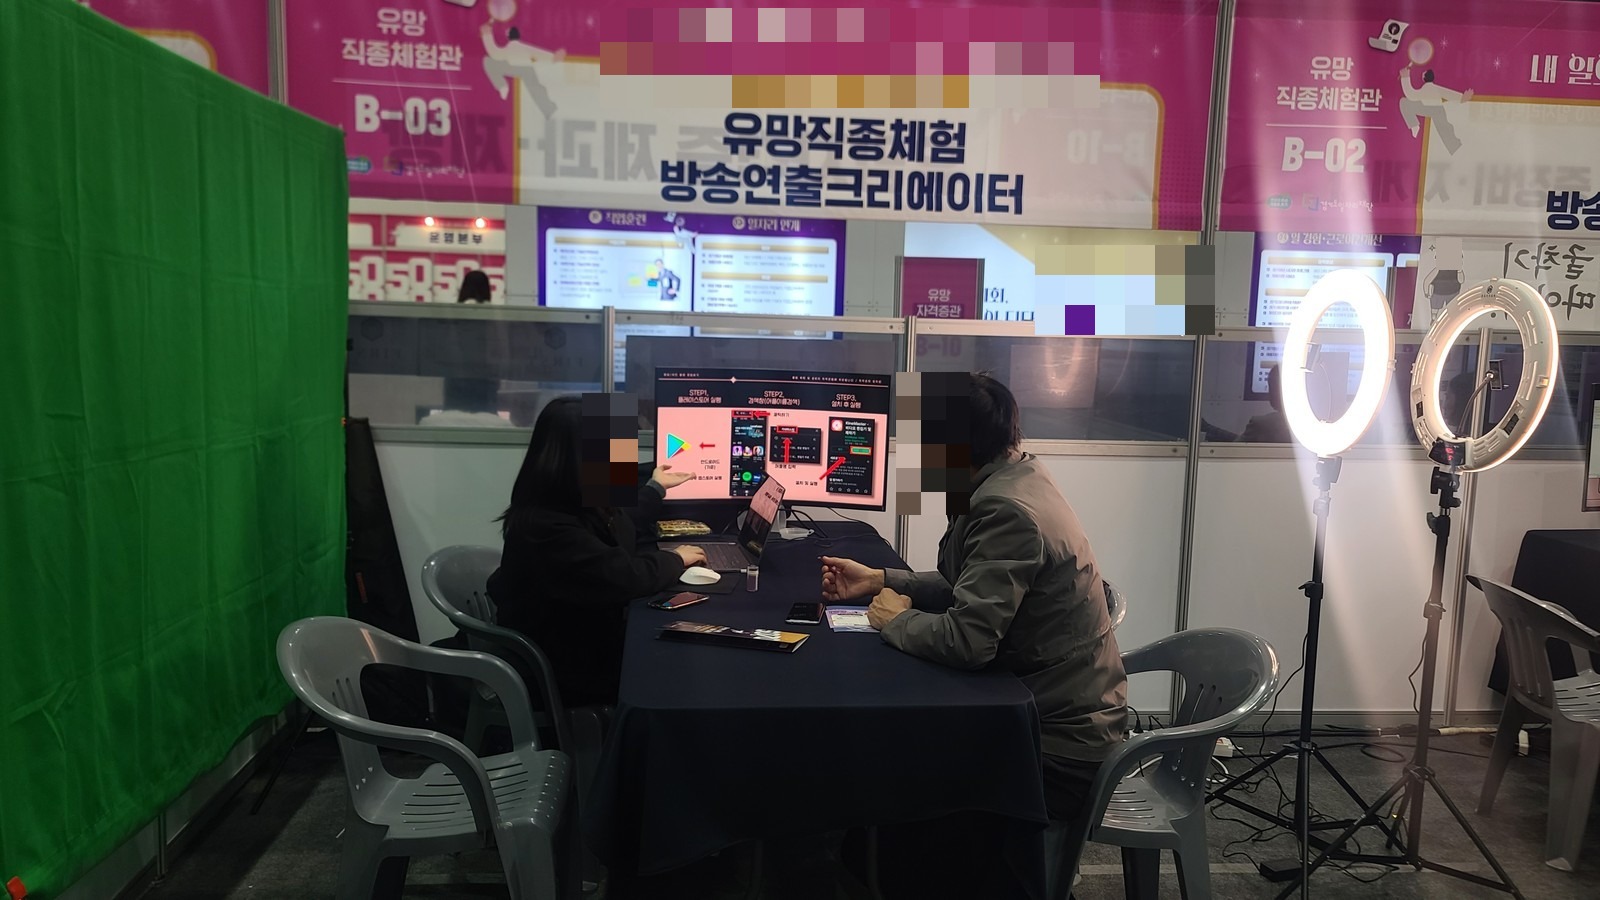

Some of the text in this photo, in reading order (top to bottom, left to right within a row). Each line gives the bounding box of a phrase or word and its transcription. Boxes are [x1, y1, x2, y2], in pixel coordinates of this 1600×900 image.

[377, 8, 427, 37] 유망
[341, 38, 463, 71] 직종체험관
[1310, 56, 1354, 82] 유망
[1529, 53, 1600, 86] 내 일
[354, 94, 451, 136] B-03
[1276, 86, 1382, 113] 직종체험관
[722, 112, 967, 164] 유망직종체험
[1281, 137, 1367, 174] B-02
[659, 160, 1025, 216] 방송연출크리에이터
[916, 303, 962, 318] 자격증관
[928, 288, 951, 302] 유망
